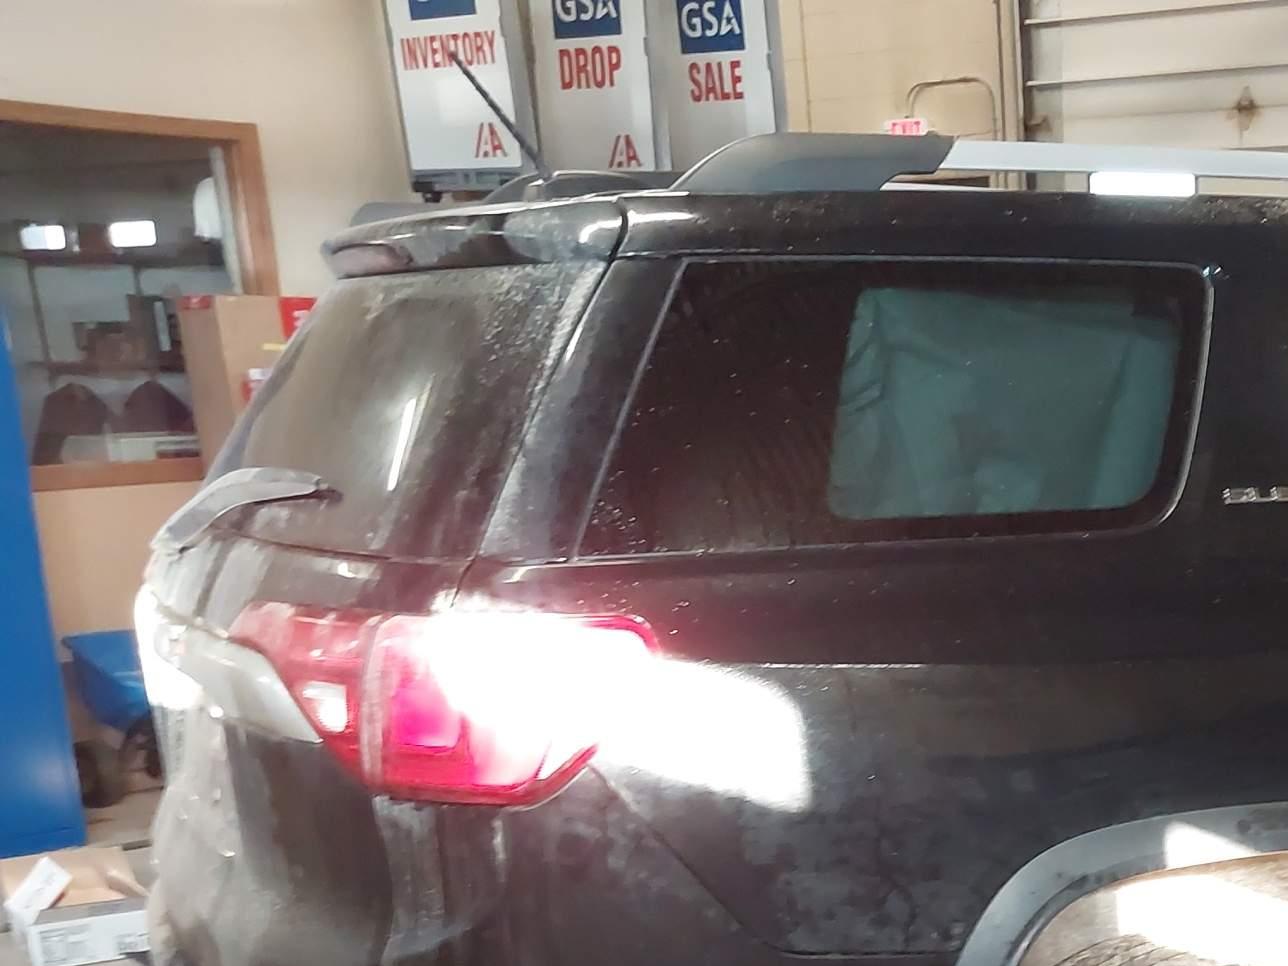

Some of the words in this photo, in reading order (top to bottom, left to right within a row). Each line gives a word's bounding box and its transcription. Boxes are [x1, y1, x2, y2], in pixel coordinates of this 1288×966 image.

[556, 0, 617, 22] GSA
[681, 1, 742, 38] GSA
[400, 30, 496, 71] INVENTORY
[558, 45, 622, 90] DROP
[688, 60, 744, 102] SALE
